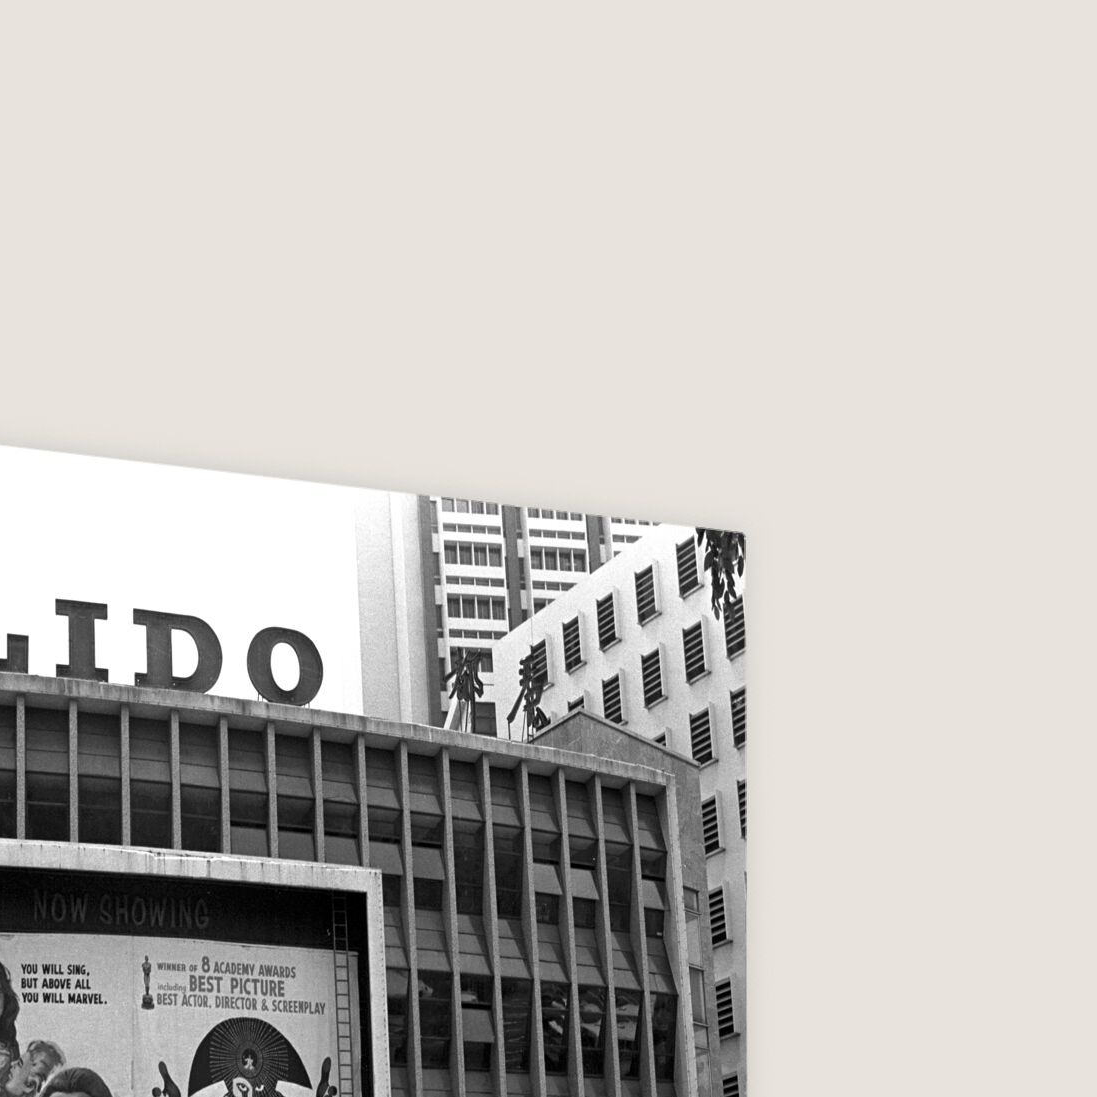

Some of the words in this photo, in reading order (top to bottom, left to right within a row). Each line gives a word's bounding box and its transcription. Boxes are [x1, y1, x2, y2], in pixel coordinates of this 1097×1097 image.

[33, 888, 88, 924] NOW
[99, 895, 210, 929] SHOWING
[21, 964, 38, 975] YOU
[42, 964, 64, 975] WILL
[157, 962, 186, 972] WINNER
[201, 956, 211, 973] 8
[213, 961, 255, 977] ACADEMY
[258, 964, 296, 979] AWARDS
[21, 978, 38, 989] BUT
[42, 978, 71, 990] ABOVE
[75, 978, 91, 990] ALL
[157, 983, 187, 993] including
[189, 974, 223, 994] BEST
[230, 977, 285, 998] PICTURE
[22, 992, 39, 1003] YOU
[43, 993, 64, 1004] WILL
[68, 993, 107, 1004] MARVEL.
[157, 993, 178, 1006] BEST
[215, 996, 257, 1011] DIRECTOR
[261, 998, 269, 1012] &
[272, 1000, 326, 1016] SCREENPLAY
